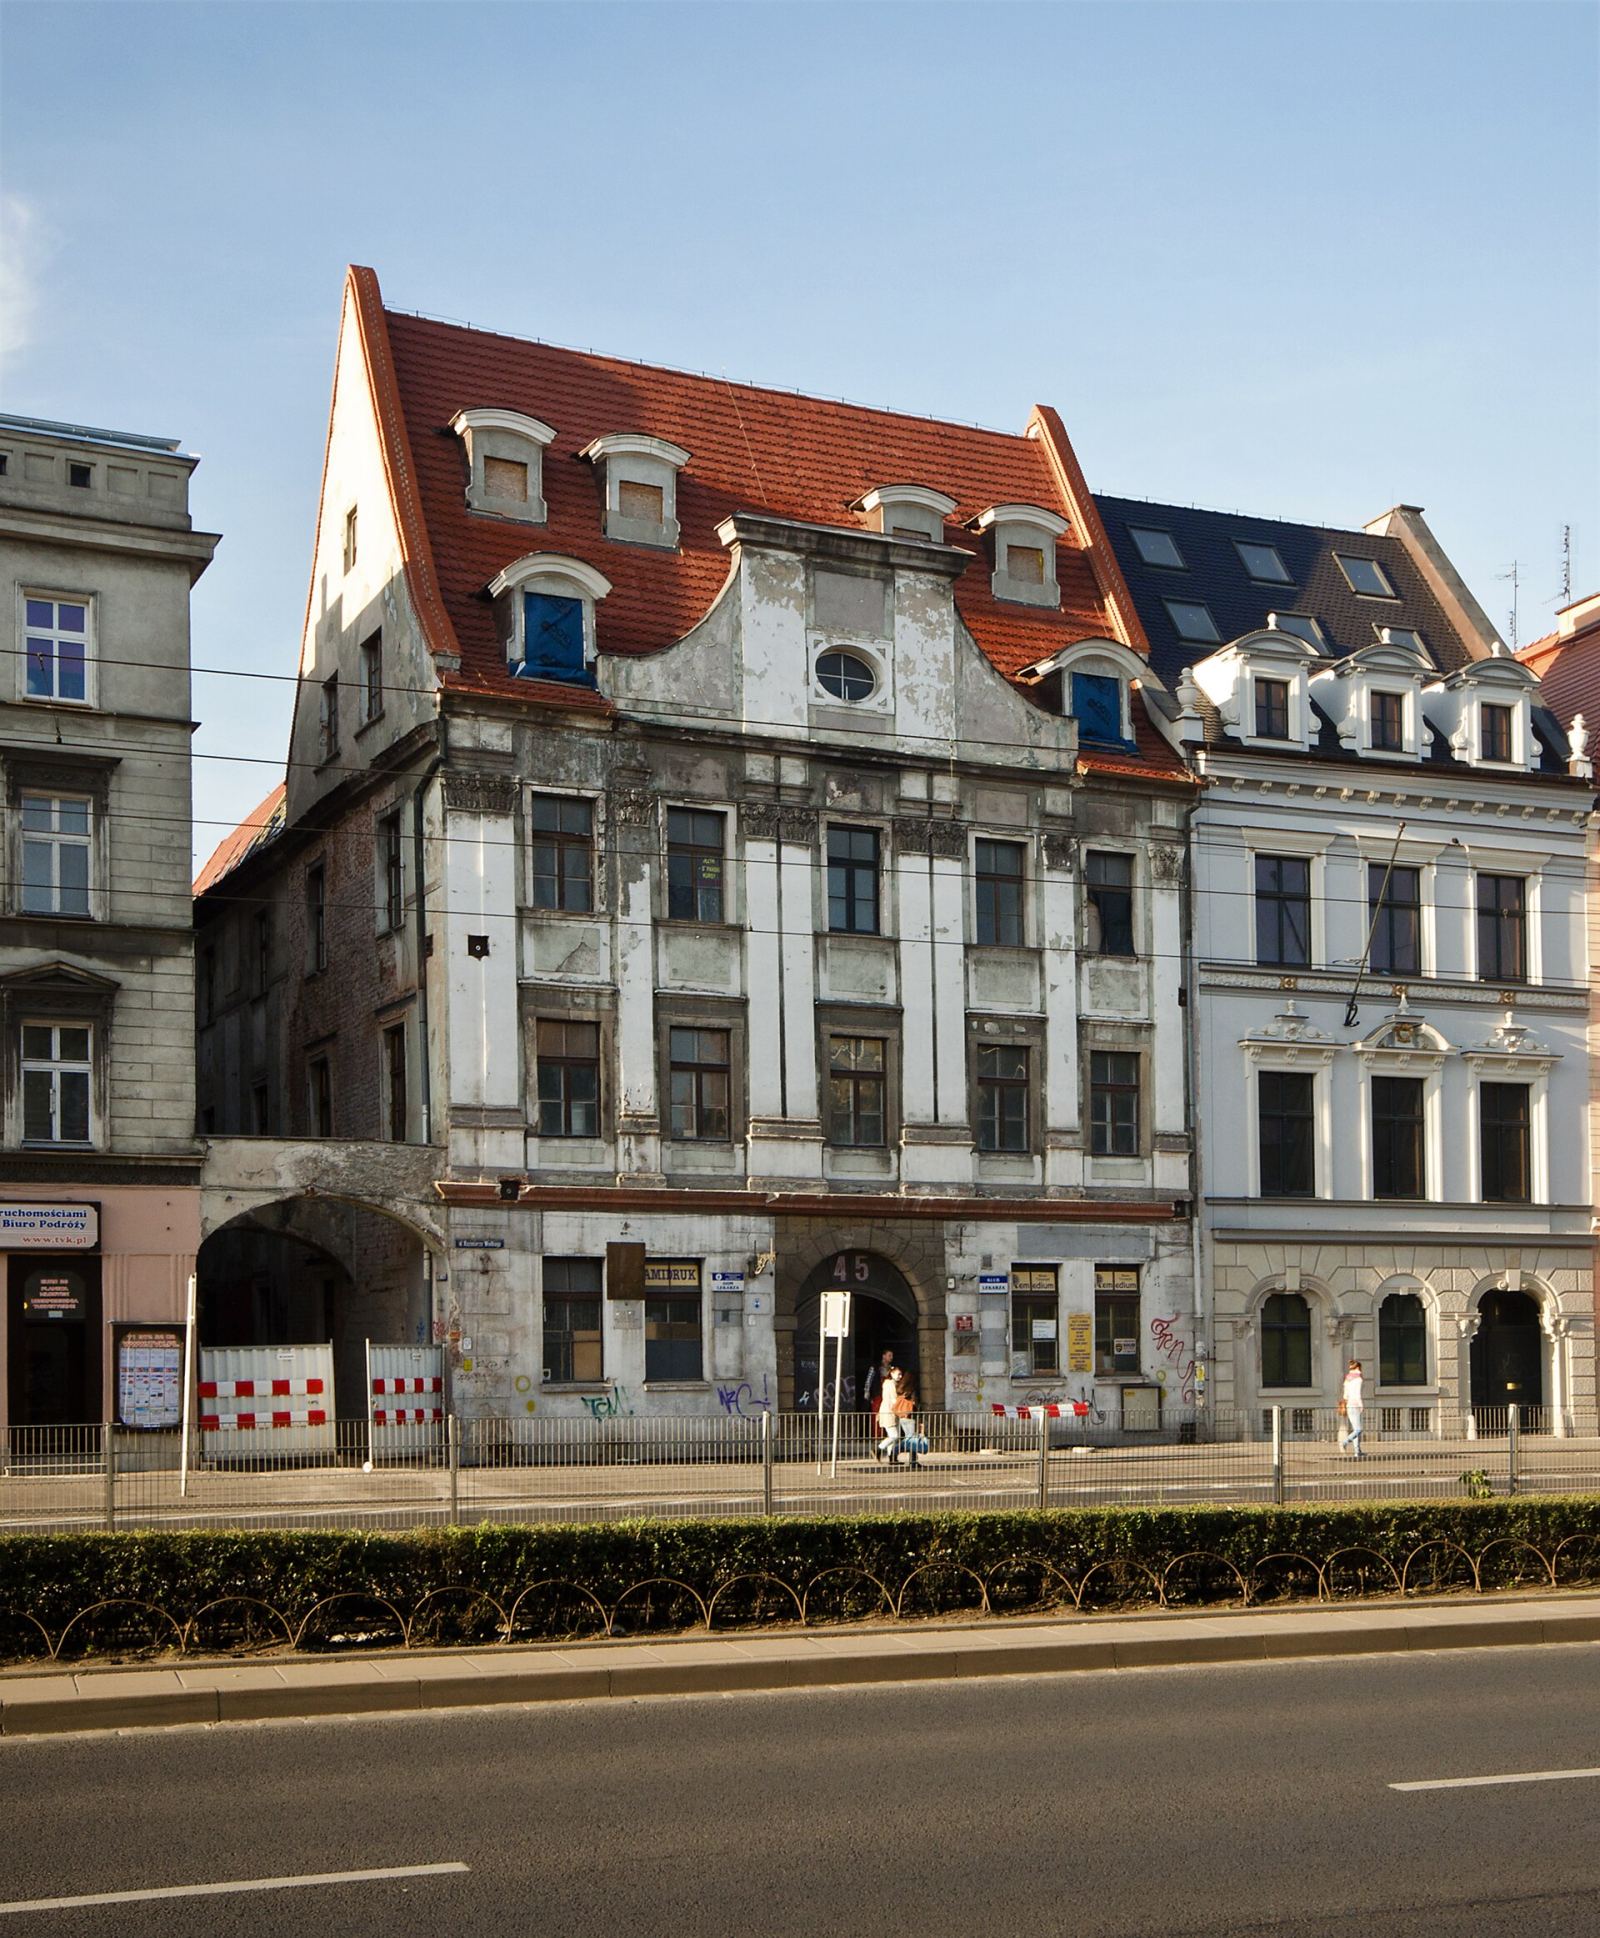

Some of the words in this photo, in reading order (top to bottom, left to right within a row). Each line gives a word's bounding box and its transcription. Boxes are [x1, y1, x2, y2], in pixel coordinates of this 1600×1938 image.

[3, 1219, 36, 1228] Biuro
[40, 1220, 87, 1230] Podróży
[23, 1236, 87, 1245] www.tvk.pl
